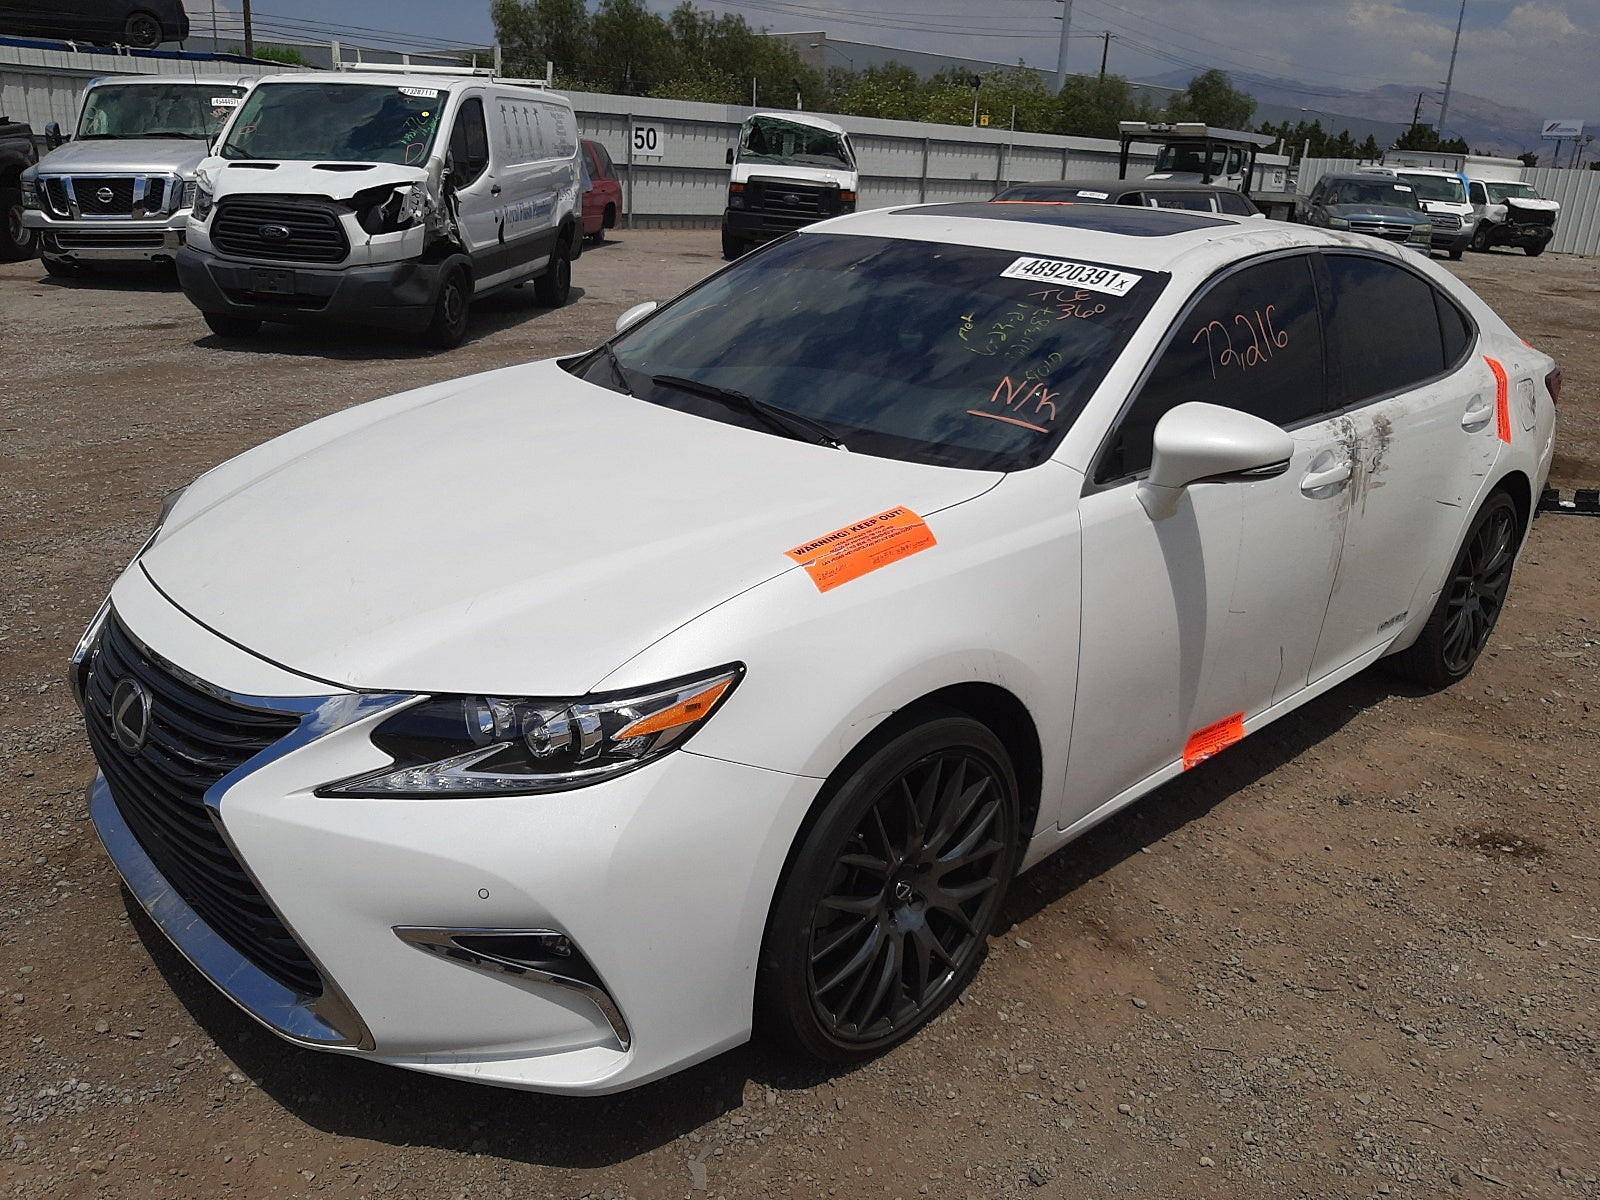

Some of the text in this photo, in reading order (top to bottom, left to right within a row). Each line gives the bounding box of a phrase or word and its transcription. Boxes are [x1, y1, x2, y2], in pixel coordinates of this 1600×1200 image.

[634, 127, 657, 150] 50
[1022, 260, 1120, 287] 48920391
[1056, 304, 1106, 320] 360
[793, 530, 851, 556] WARNING!
[850, 519, 877, 533] KEEP
[879, 509, 905, 521] OUT!
